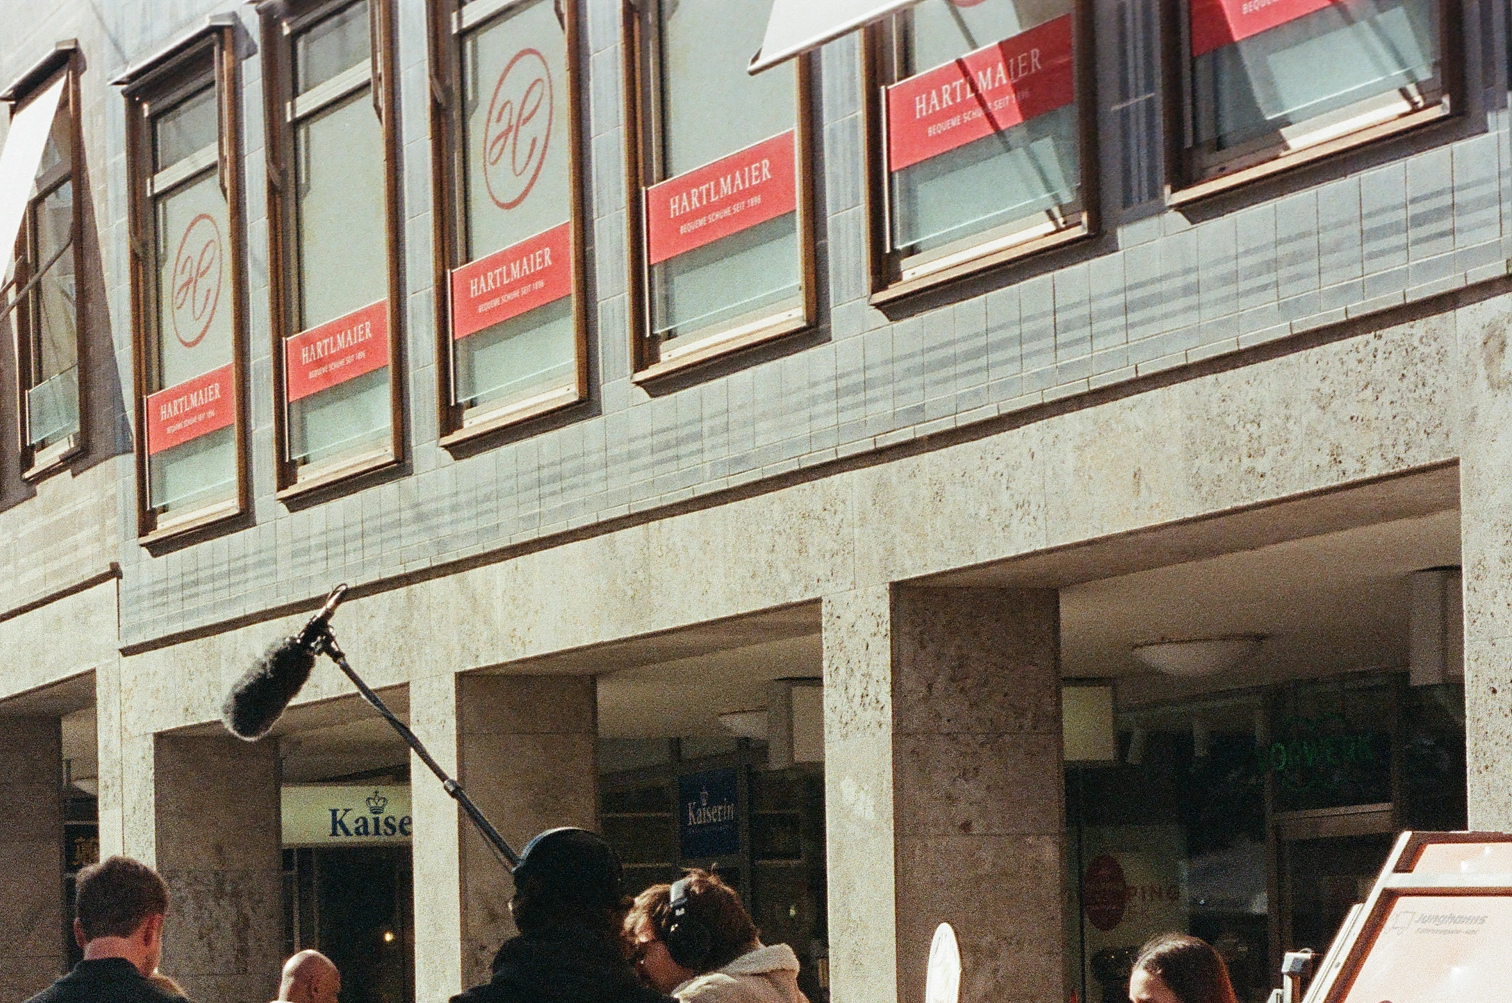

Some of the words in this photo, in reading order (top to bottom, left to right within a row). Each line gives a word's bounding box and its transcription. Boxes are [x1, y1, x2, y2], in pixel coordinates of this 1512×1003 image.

[915, 47, 1043, 119] HARTLMAIER
[928, 115, 961, 137] BEQUEME
[993, 95, 1010, 111] SEIT
[669, 158, 772, 219] HARTLMAIER
[679, 216, 707, 235] BEQUEME
[707, 206, 732, 224] SCHUHE
[469, 247, 553, 298] HARTLMAIER
[300, 321, 373, 365] HARTLMAIER
[160, 382, 222, 422] HARTLMAIER
